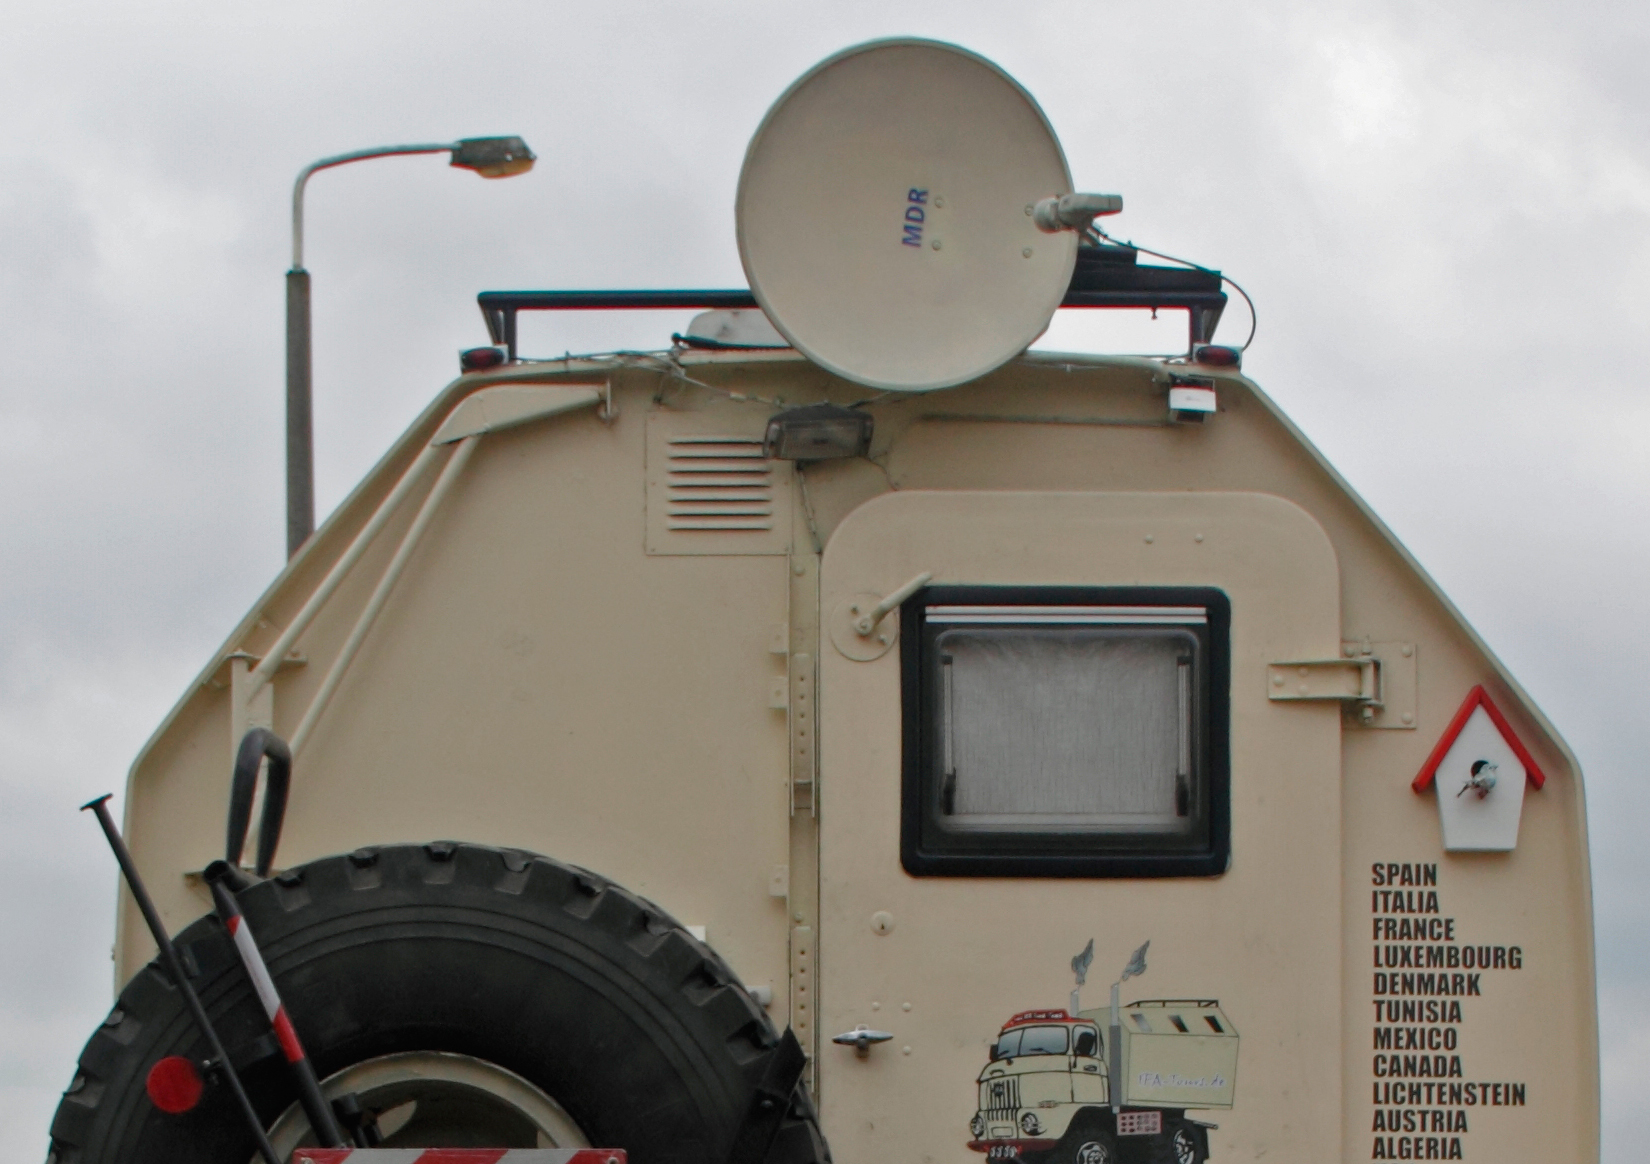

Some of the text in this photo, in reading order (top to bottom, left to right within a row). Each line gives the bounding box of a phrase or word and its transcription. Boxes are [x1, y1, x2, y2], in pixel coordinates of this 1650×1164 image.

[901, 187, 929, 248] MDR
[1372, 863, 1437, 886] SPAIN
[1372, 890, 1439, 914] ITALIA
[1373, 918, 1455, 941] FRANCE
[1373, 945, 1522, 969] LUXEMBOURG
[1373, 973, 1481, 996] DENMARK
[1373, 1000, 1462, 1023] TUNISIA
[1373, 1028, 1457, 1050] MEXICO
[1373, 1055, 1463, 1078] CANADA
[1373, 1082, 1526, 1106] LICHTENSTEIN
[1372, 1110, 1468, 1132] AUSTRIA
[1372, 1137, 1463, 1160] ALGERIA
